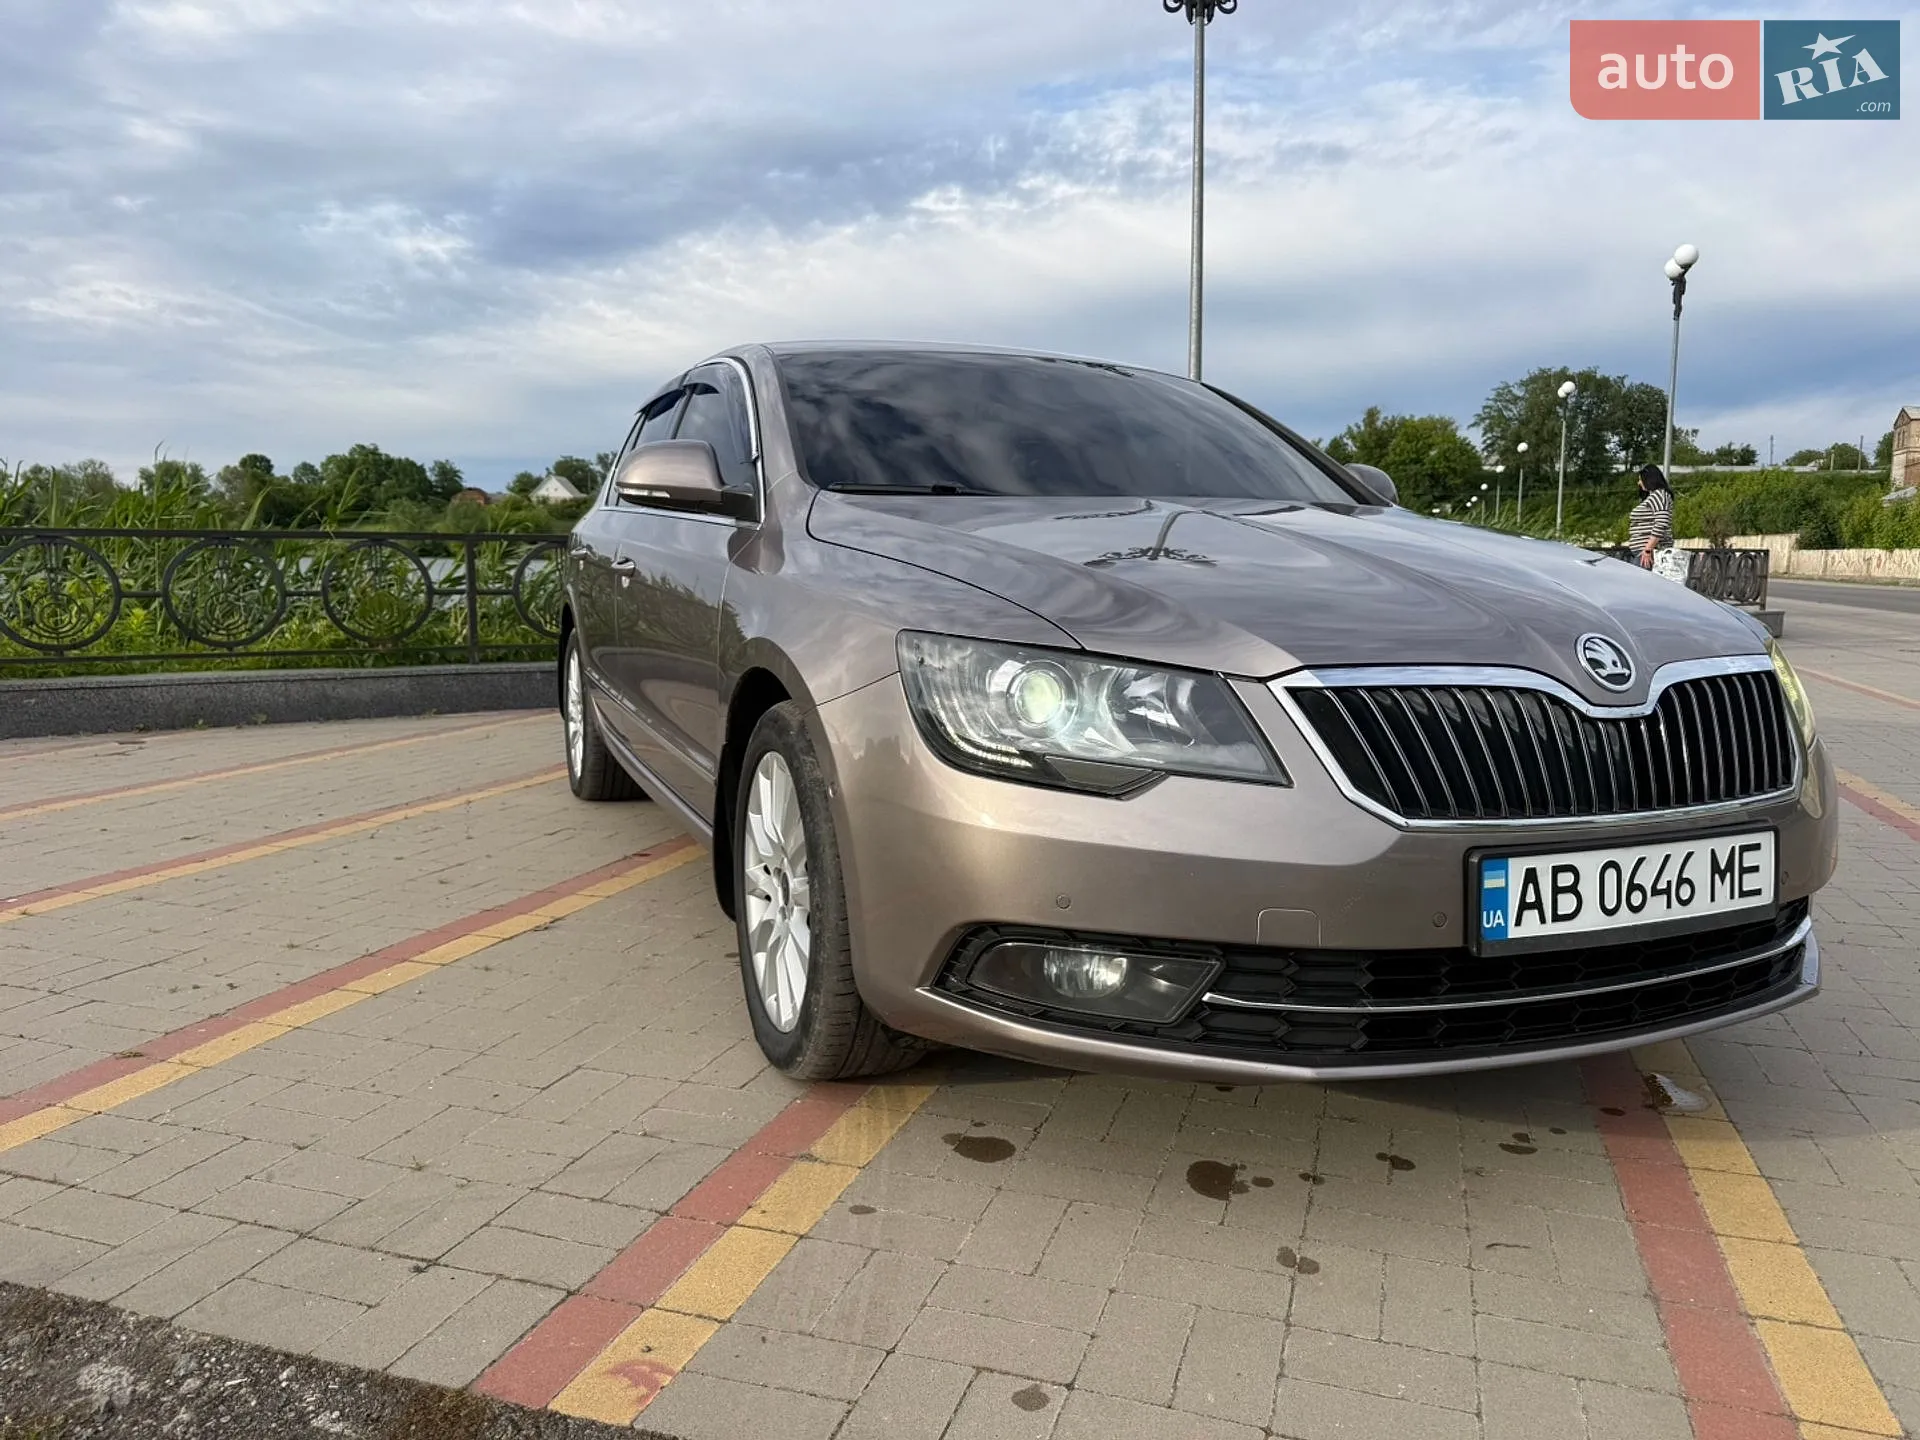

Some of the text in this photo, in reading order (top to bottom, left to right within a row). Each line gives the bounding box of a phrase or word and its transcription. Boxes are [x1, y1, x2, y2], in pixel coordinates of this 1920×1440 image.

[1514, 843, 1762, 926] AB 0646 ME
[1483, 910, 1505, 928] UA
